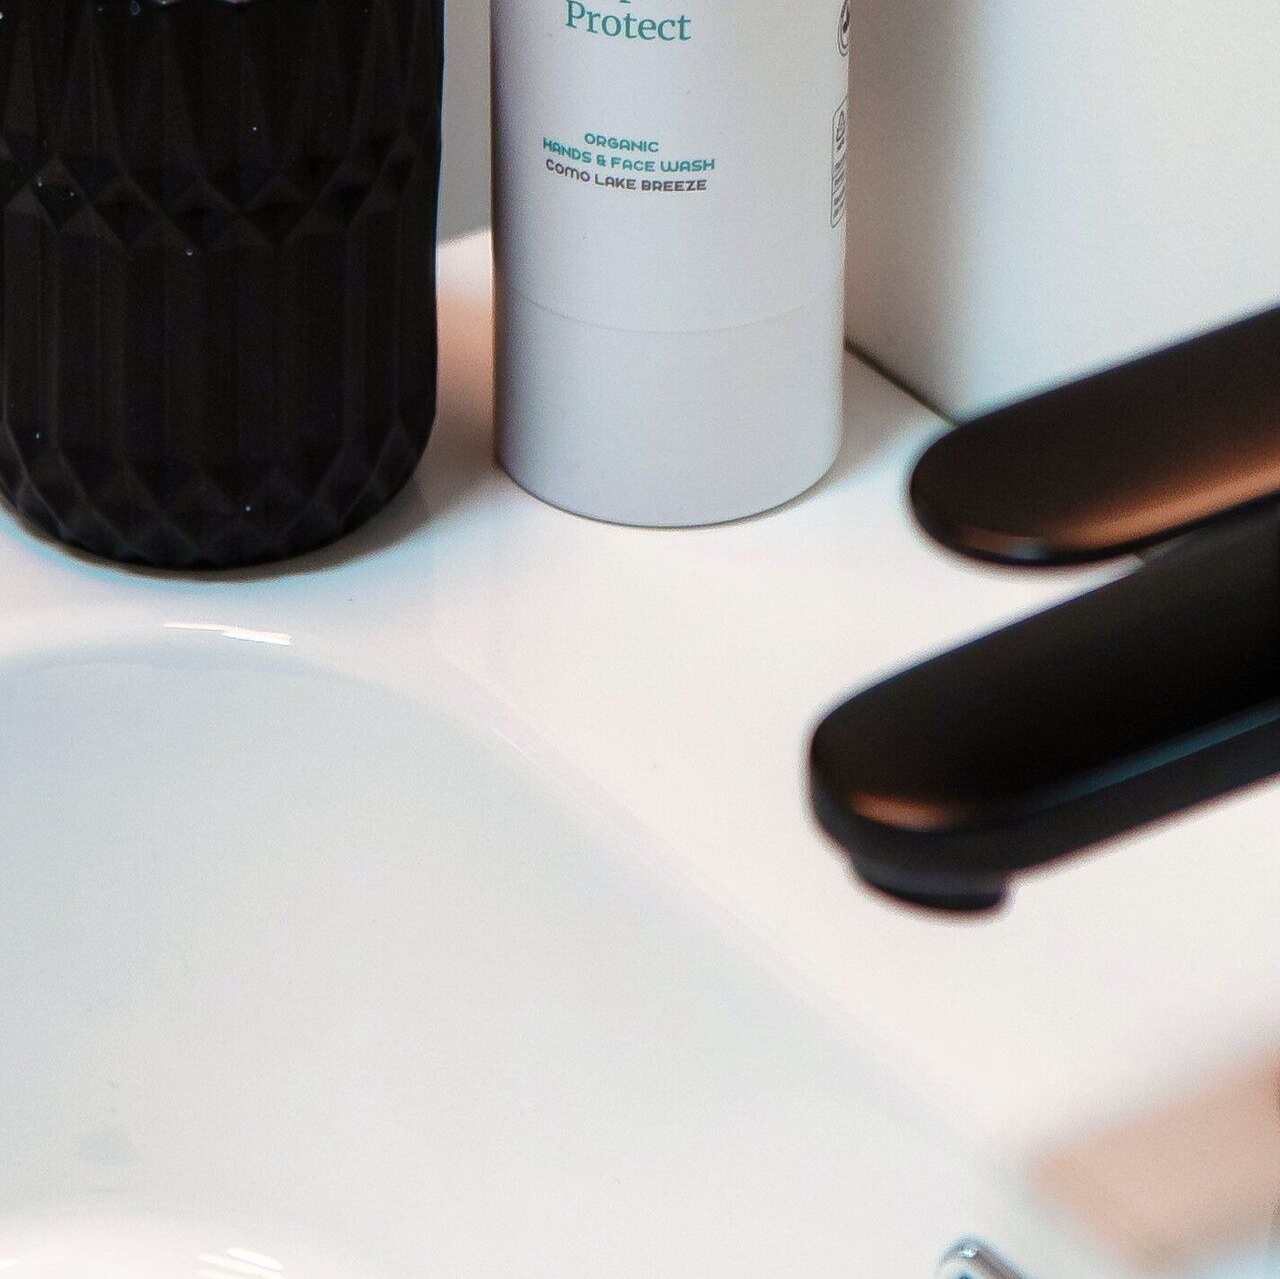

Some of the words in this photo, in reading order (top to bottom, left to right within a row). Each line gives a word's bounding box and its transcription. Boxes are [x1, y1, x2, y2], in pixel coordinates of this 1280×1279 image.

[565, 0, 692, 41] Protect
[543, 137, 592, 164] HANDS
[596, 154, 607, 167] &
[610, 156, 656, 172] FACE
[660, 158, 716, 173] WASH
[584, 133, 659, 153] ORGANIC
[594, 173, 637, 190] LAKE
[641, 179, 708, 192] BREEZE
